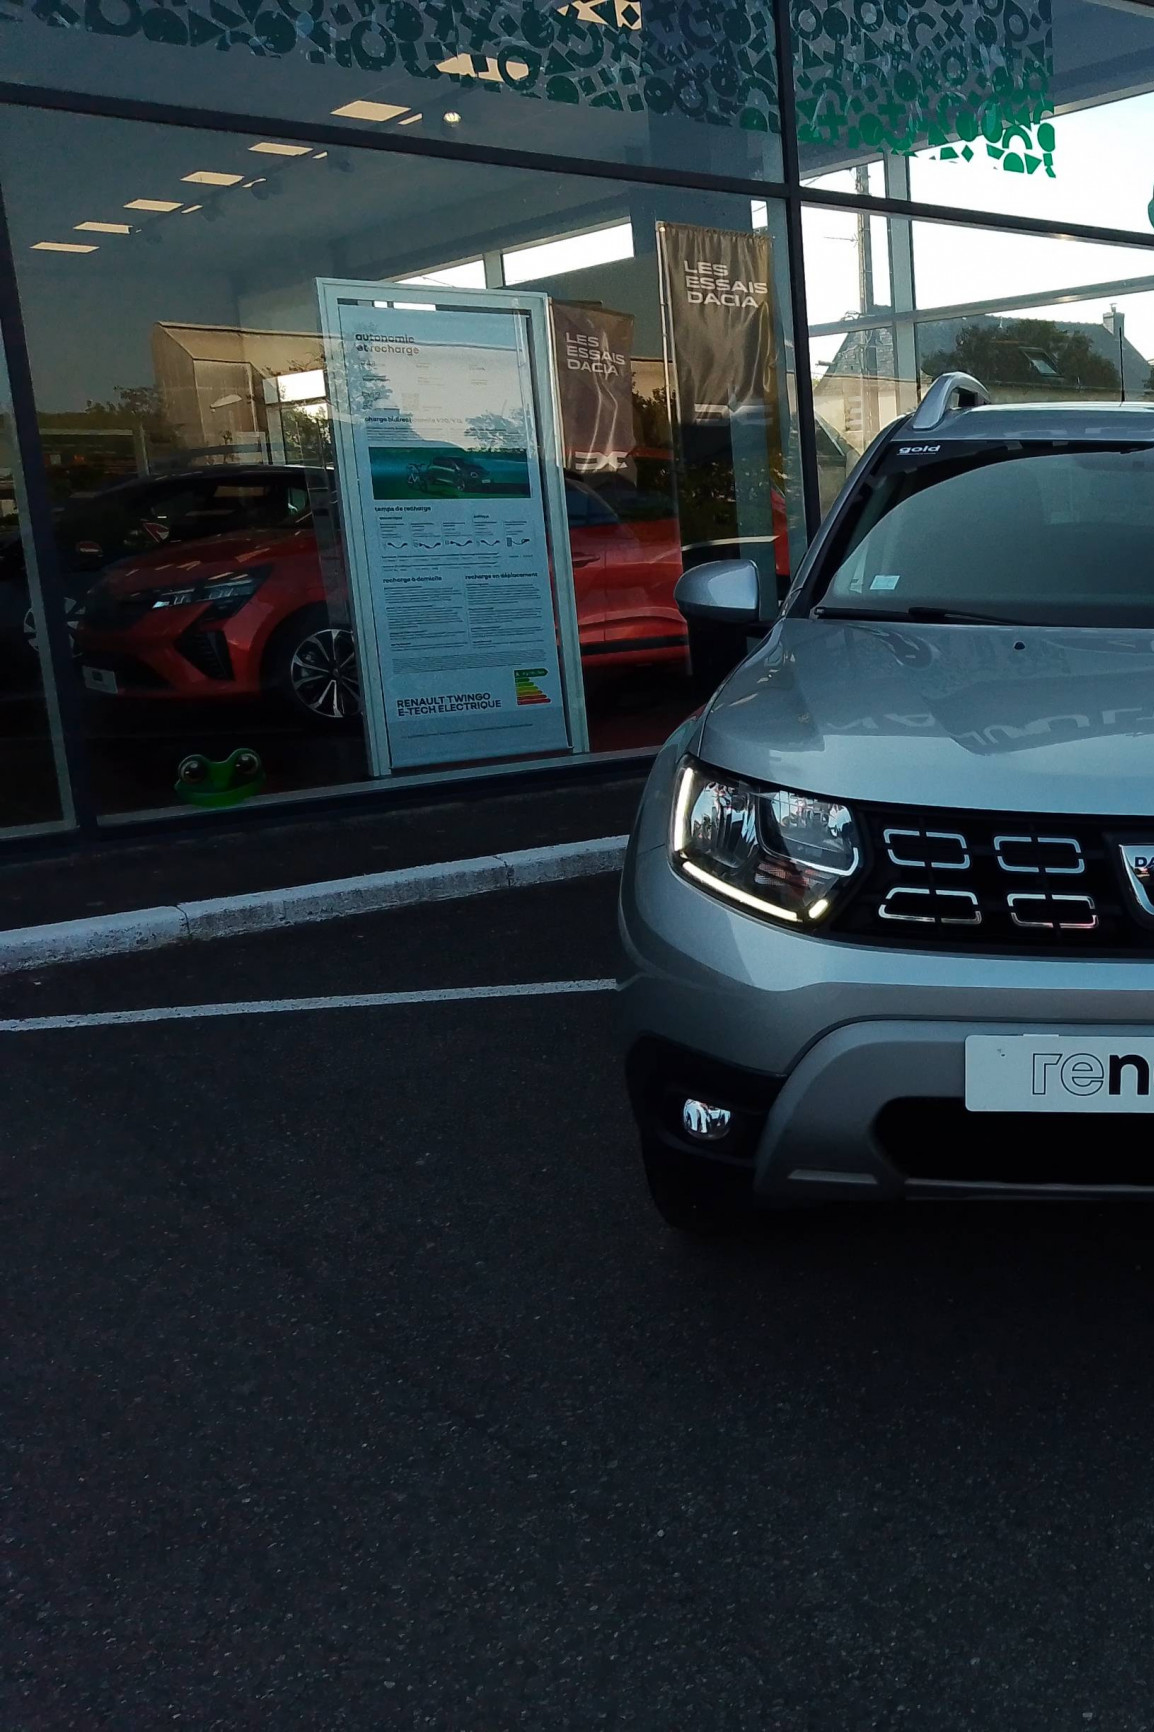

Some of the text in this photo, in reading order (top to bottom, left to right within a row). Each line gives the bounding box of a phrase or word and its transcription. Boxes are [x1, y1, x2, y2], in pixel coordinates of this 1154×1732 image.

[684, 260, 729, 276] LES
[685, 276, 768, 294] ESSAIS
[687, 290, 759, 308] DACIA
[565, 332, 600, 348] LES
[370, 344, 420, 356] recharge
[566, 345, 626, 365] ESSAIS
[567, 358, 619, 377] DACIA
[898, 444, 941, 454] gold
[397, 692, 491, 708] RENAULT TWINGO
[397, 699, 502, 717] E-TECH ELECTRIQUE
